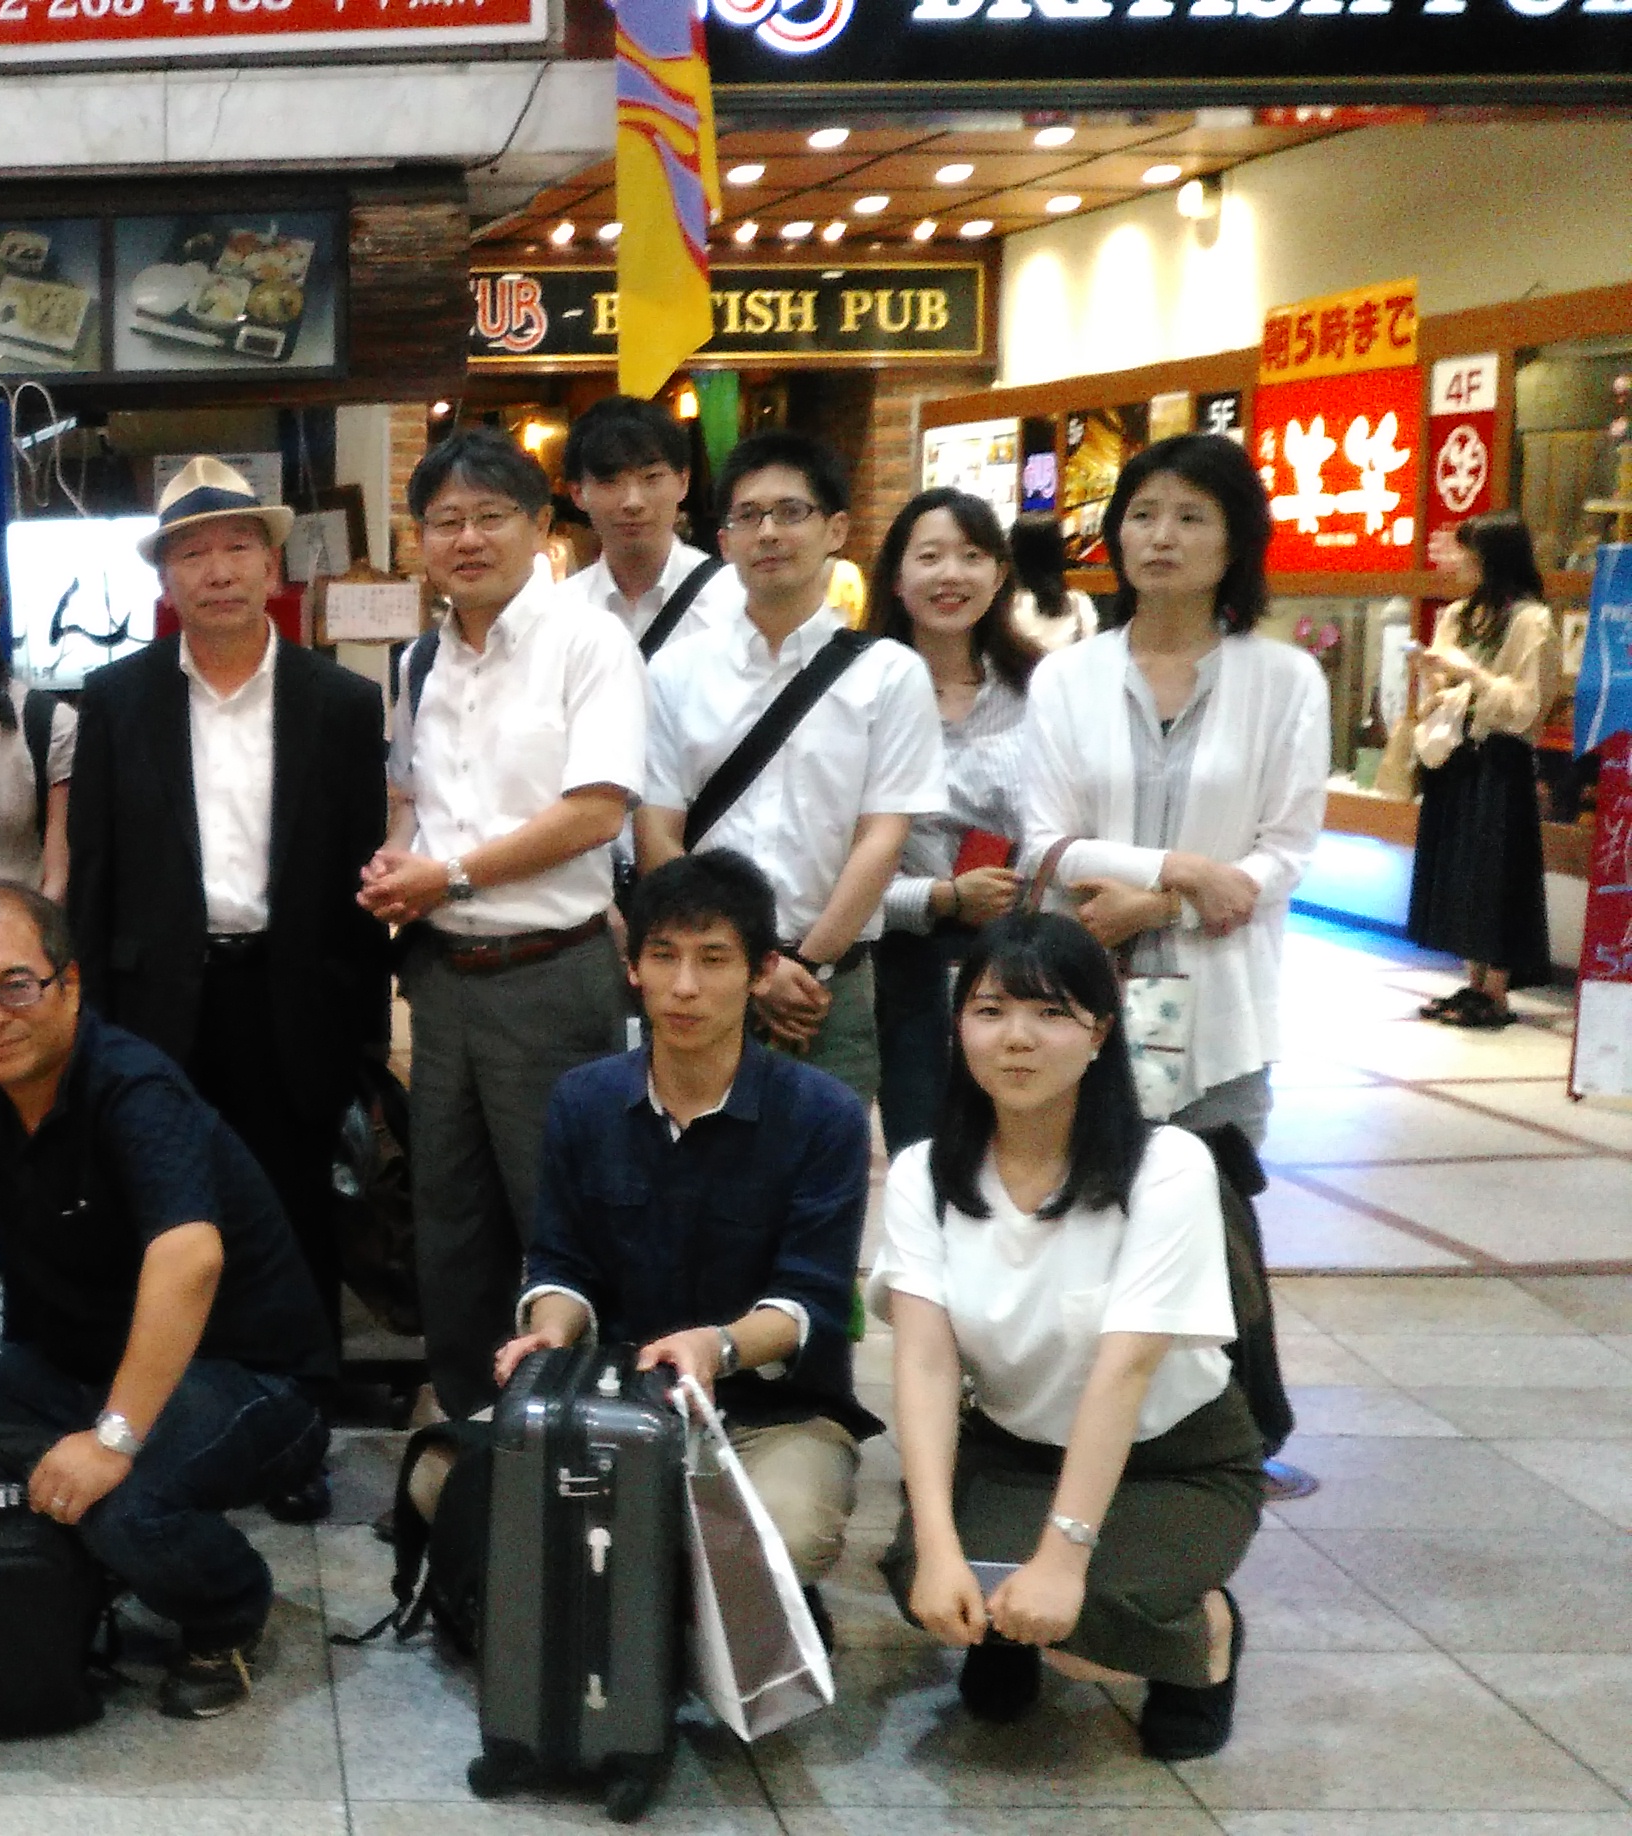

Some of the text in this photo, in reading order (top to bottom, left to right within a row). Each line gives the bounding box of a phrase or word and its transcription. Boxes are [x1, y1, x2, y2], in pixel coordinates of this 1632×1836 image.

[469, 276, 949, 352] UB BISH PUB
[1446, 369, 1483, 404] 4F
